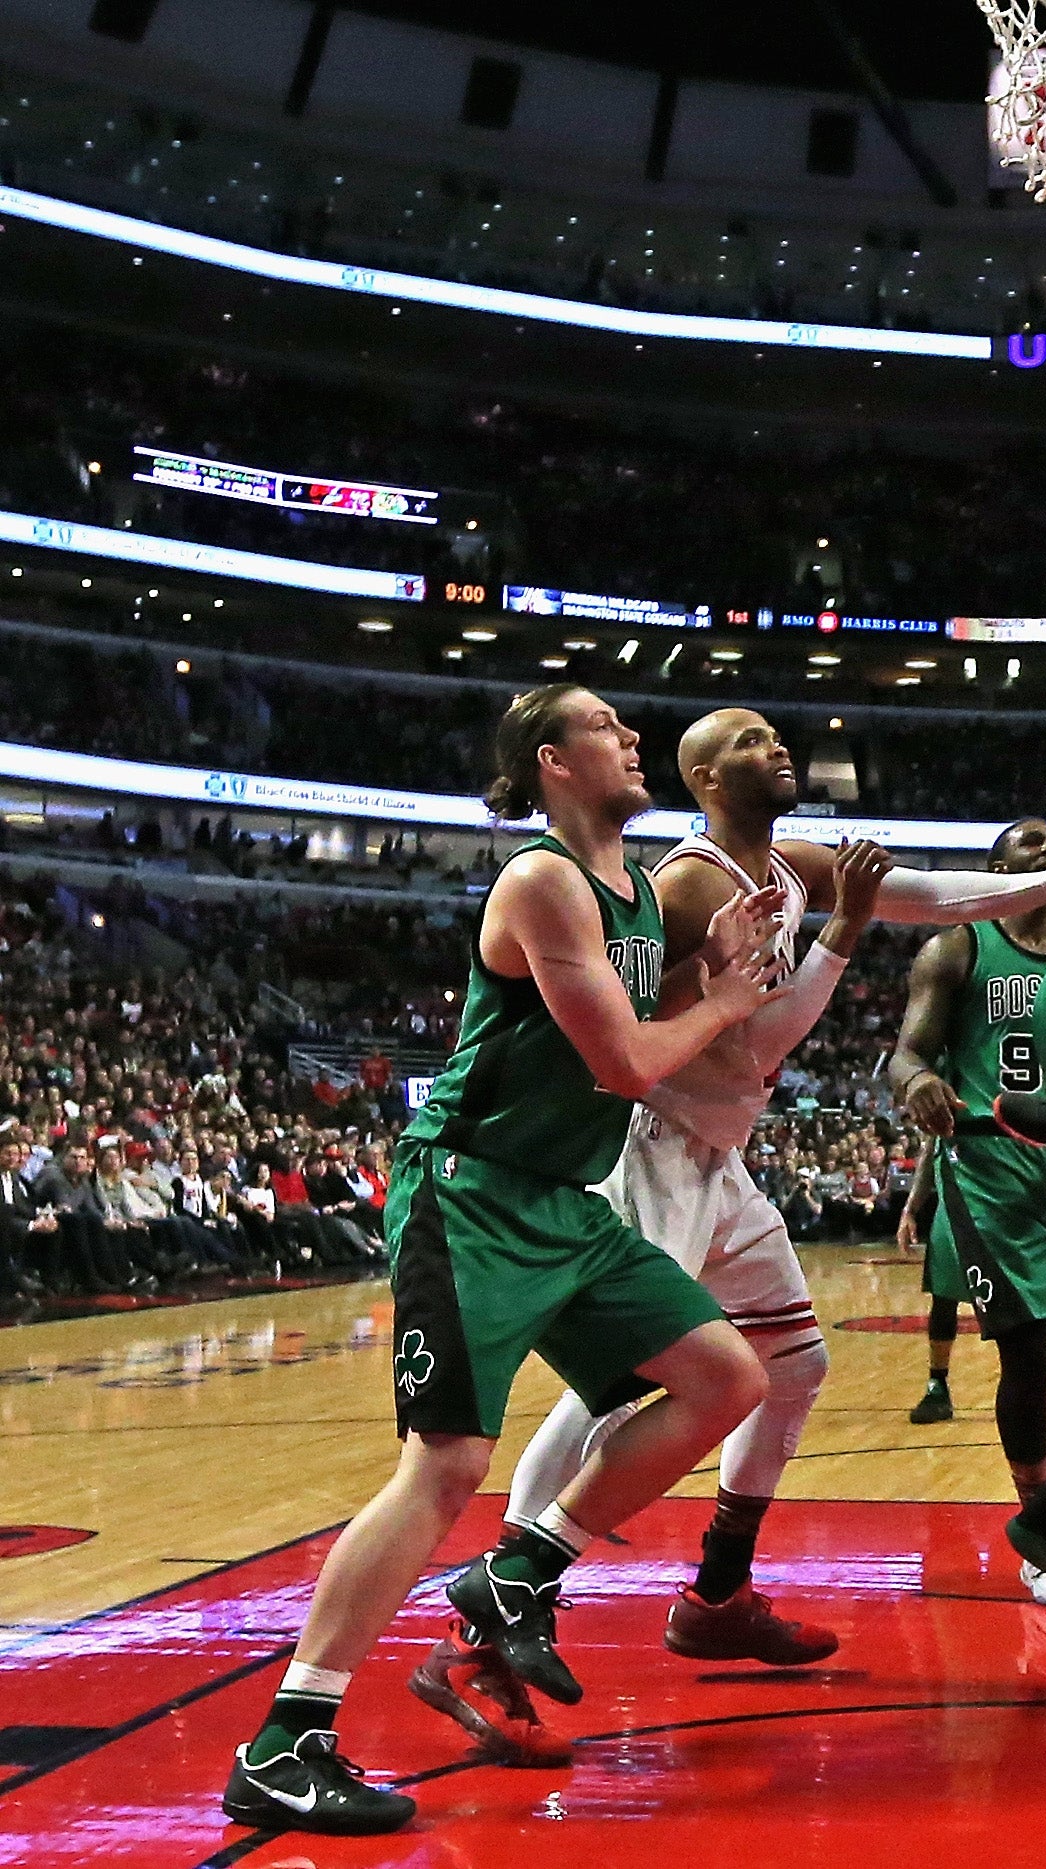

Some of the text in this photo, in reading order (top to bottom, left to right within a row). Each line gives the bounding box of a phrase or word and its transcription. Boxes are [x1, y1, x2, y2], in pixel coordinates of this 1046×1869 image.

[727, 609, 748, 624] 1st
[782, 614, 938, 632] BMO HARRIS CLUB
[999, 1032, 1043, 1094] 9
